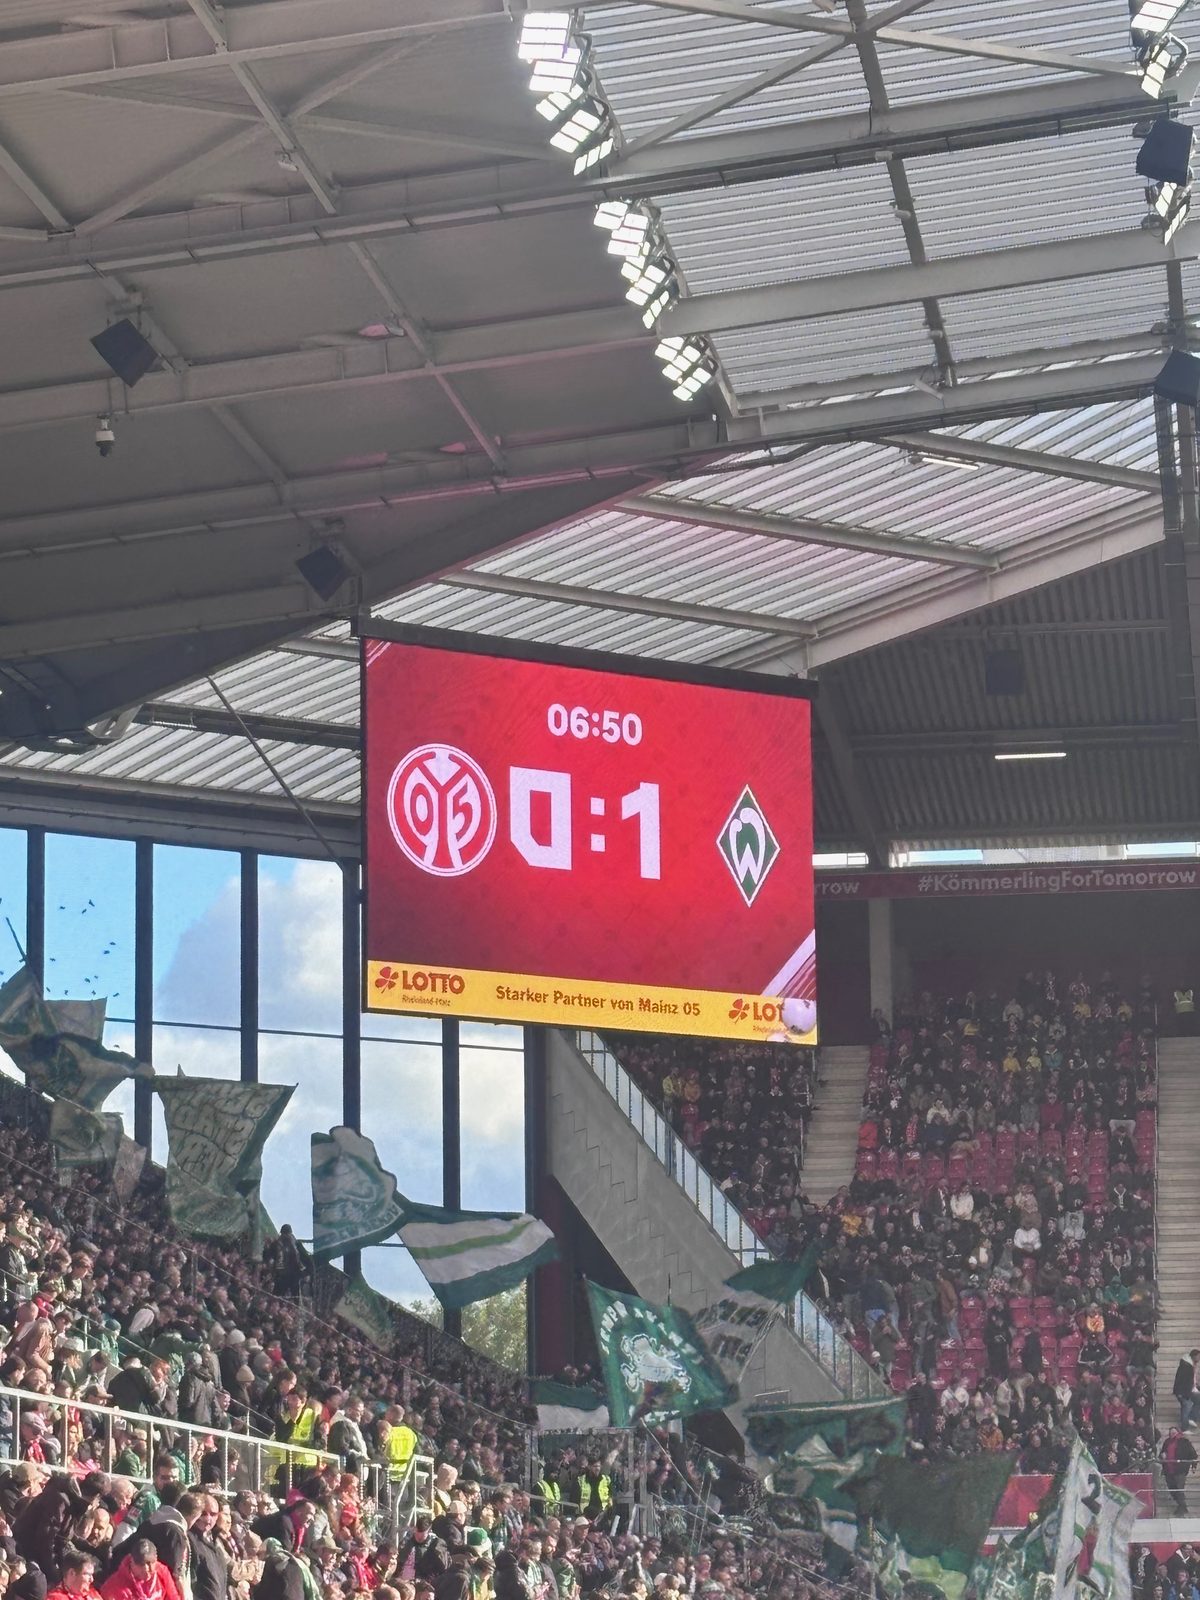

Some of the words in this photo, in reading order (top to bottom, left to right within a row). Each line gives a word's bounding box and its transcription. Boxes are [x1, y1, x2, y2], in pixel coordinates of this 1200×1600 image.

[547, 703, 642, 746] 06:50
[917, 868, 1197, 893] #KömmerlingForTomorrow
[402, 970, 466, 995] LOTTO
[495, 984, 549, 1004] Starker
[553, 989, 608, 1010] Partner
[610, 998, 634, 1011] von
[638, 996, 680, 1016] Mainz
[682, 1001, 701, 1017] 05
